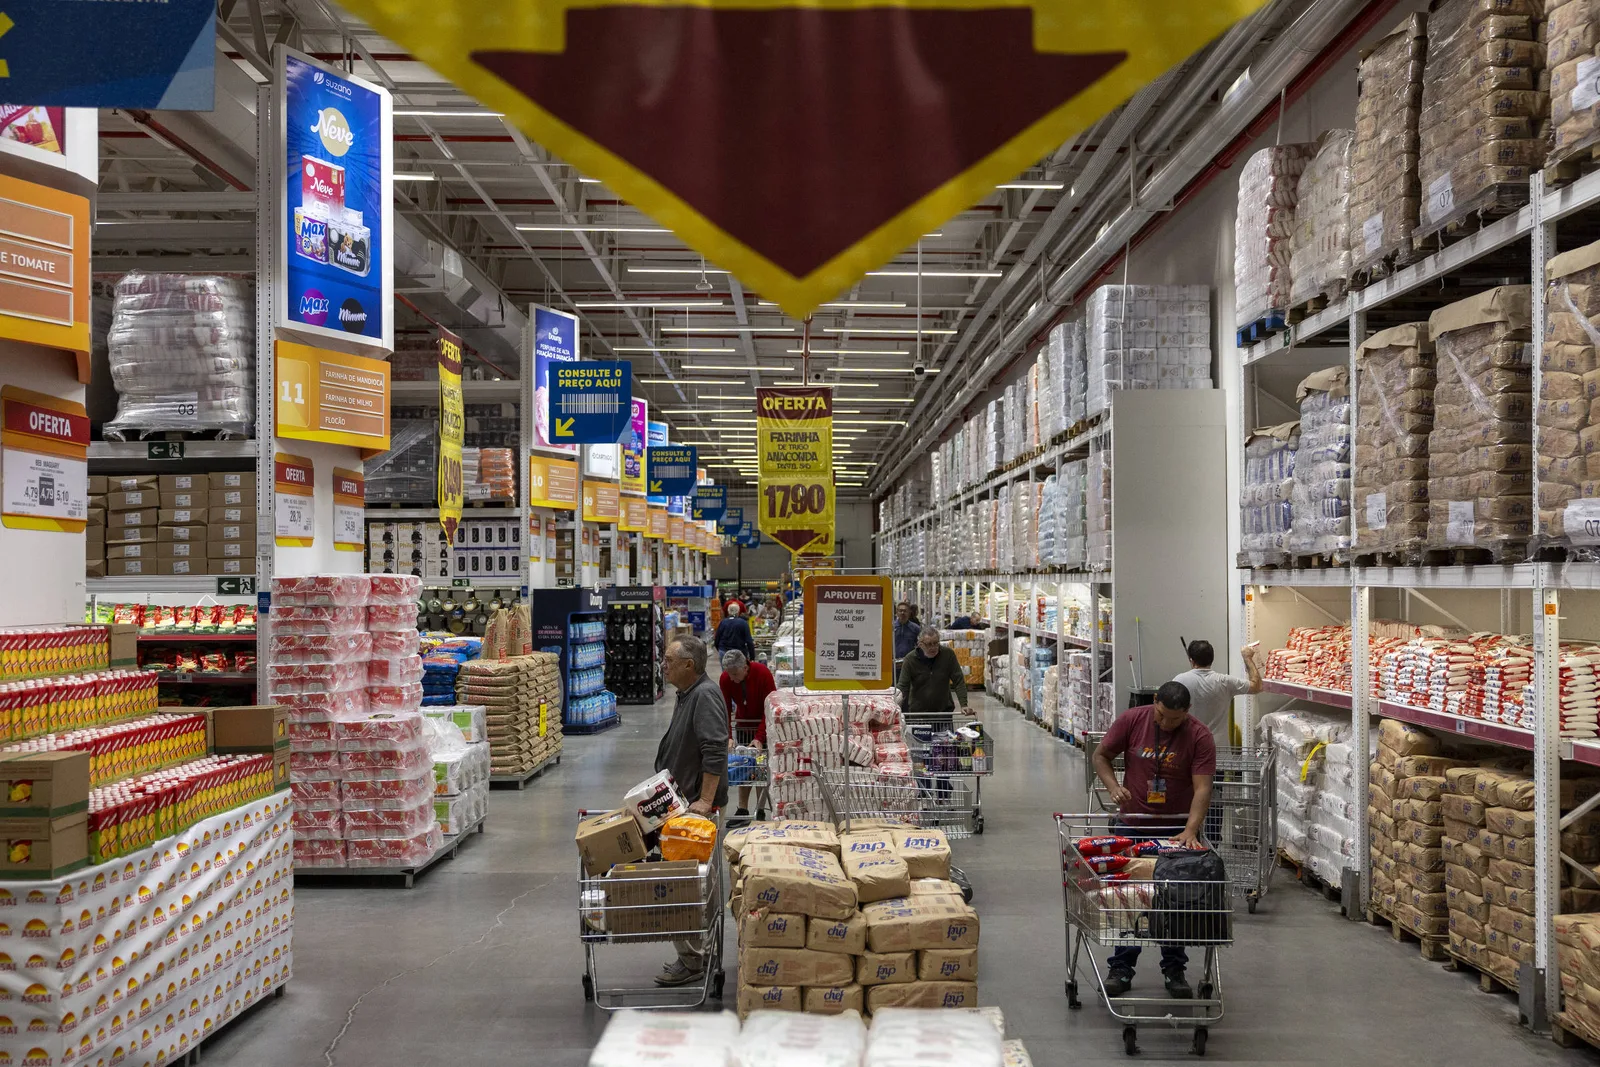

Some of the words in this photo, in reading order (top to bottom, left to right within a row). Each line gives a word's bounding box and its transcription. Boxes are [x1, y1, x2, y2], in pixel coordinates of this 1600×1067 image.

[326, 79, 352, 96] suzano
[310, 110, 354, 146] Neve
[310, 177, 334, 196] Neve
[301, 221, 326, 239] Max
[11, 253, 56, 274] TOMATE
[300, 296, 329, 314] Max
[440, 338, 462, 364] OFERTA
[326, 370, 348, 380] FARINHA
[357, 376, 384, 386] MANDIOCA
[558, 369, 611, 378] CONSULTE
[615, 369, 622, 377] O
[559, 379, 592, 389] PREÇO
[595, 379, 621, 388] AQUI
[281, 380, 304, 404] 11
[326, 393, 348, 403] FARINHA
[357, 399, 373, 408] MILHO
[762, 397, 827, 410] OFERTA
[178, 404, 194, 415] 03
[29, 411, 72, 437] OFERTA
[770, 432, 820, 443] FARINHA
[766, 452, 818, 462] ANACONDA
[286, 468, 305, 482] OFERTA
[532, 475, 543, 487] 10
[24, 486, 38, 500] 4,79
[342, 481, 358, 494] OFERTA
[56, 490, 70, 502] 5,10
[584, 496, 593, 506] 09
[764, 484, 826, 519] 17,90
[824, 590, 877, 600] APROVEITE
[820, 650, 835, 658] 2,55
[840, 650, 855, 658] 2,55
[861, 651, 876, 659] 2,65
[638, 788, 674, 813] Personal
[757, 889, 780, 904] chef
[767, 919, 787, 933] chef
[828, 924, 848, 939] chef
[947, 924, 968, 939] chef
[757, 962, 779, 976] chef
[876, 965, 896, 979] chef
[940, 961, 960, 975] chef
[763, 988, 782, 1003] chef
[824, 988, 844, 1003] chef
[943, 991, 965, 1007] chef
